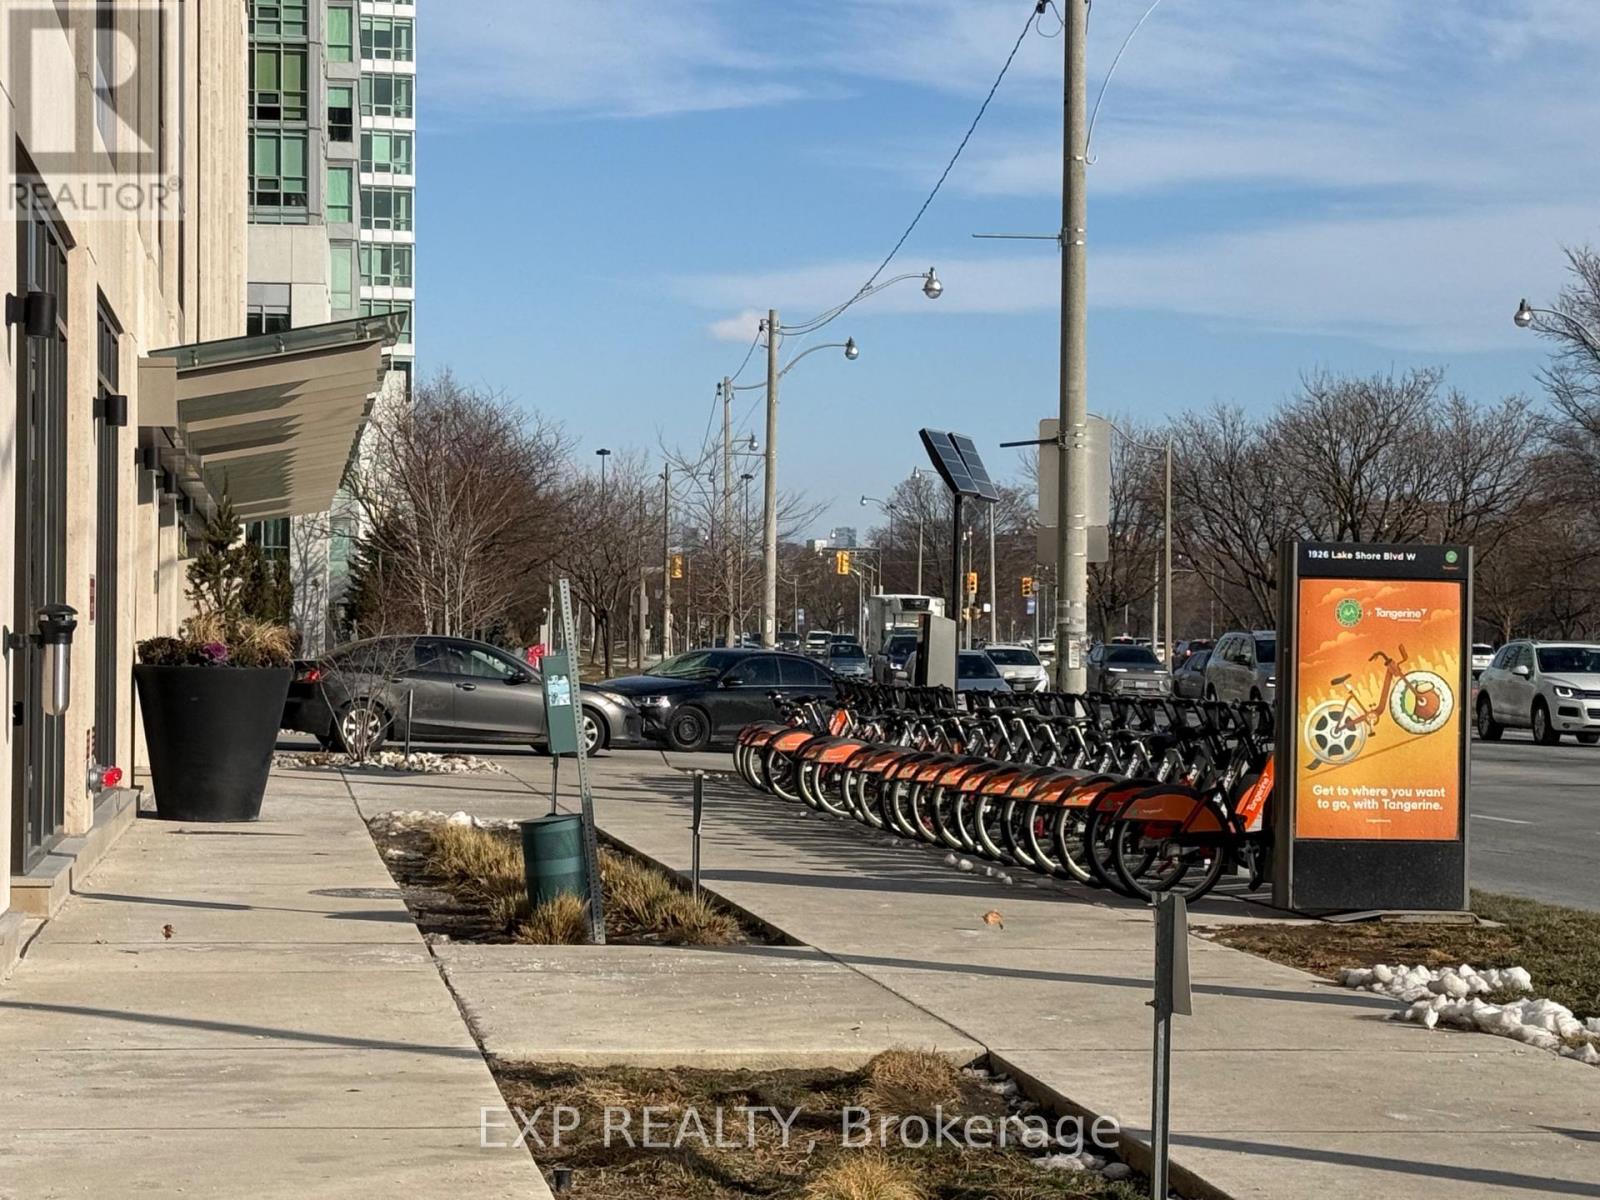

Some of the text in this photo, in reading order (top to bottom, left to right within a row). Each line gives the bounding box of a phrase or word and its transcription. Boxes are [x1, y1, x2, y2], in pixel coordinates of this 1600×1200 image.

[1308, 550, 1416, 561] 1926 Lake Shore Blvd W
[1375, 607, 1422, 620] Tangerine
[1246, 777, 1269, 811] Tangerine
[1312, 784, 1446, 799] Get to where you want
[1317, 798, 1443, 812] to go, with Tangerine.
